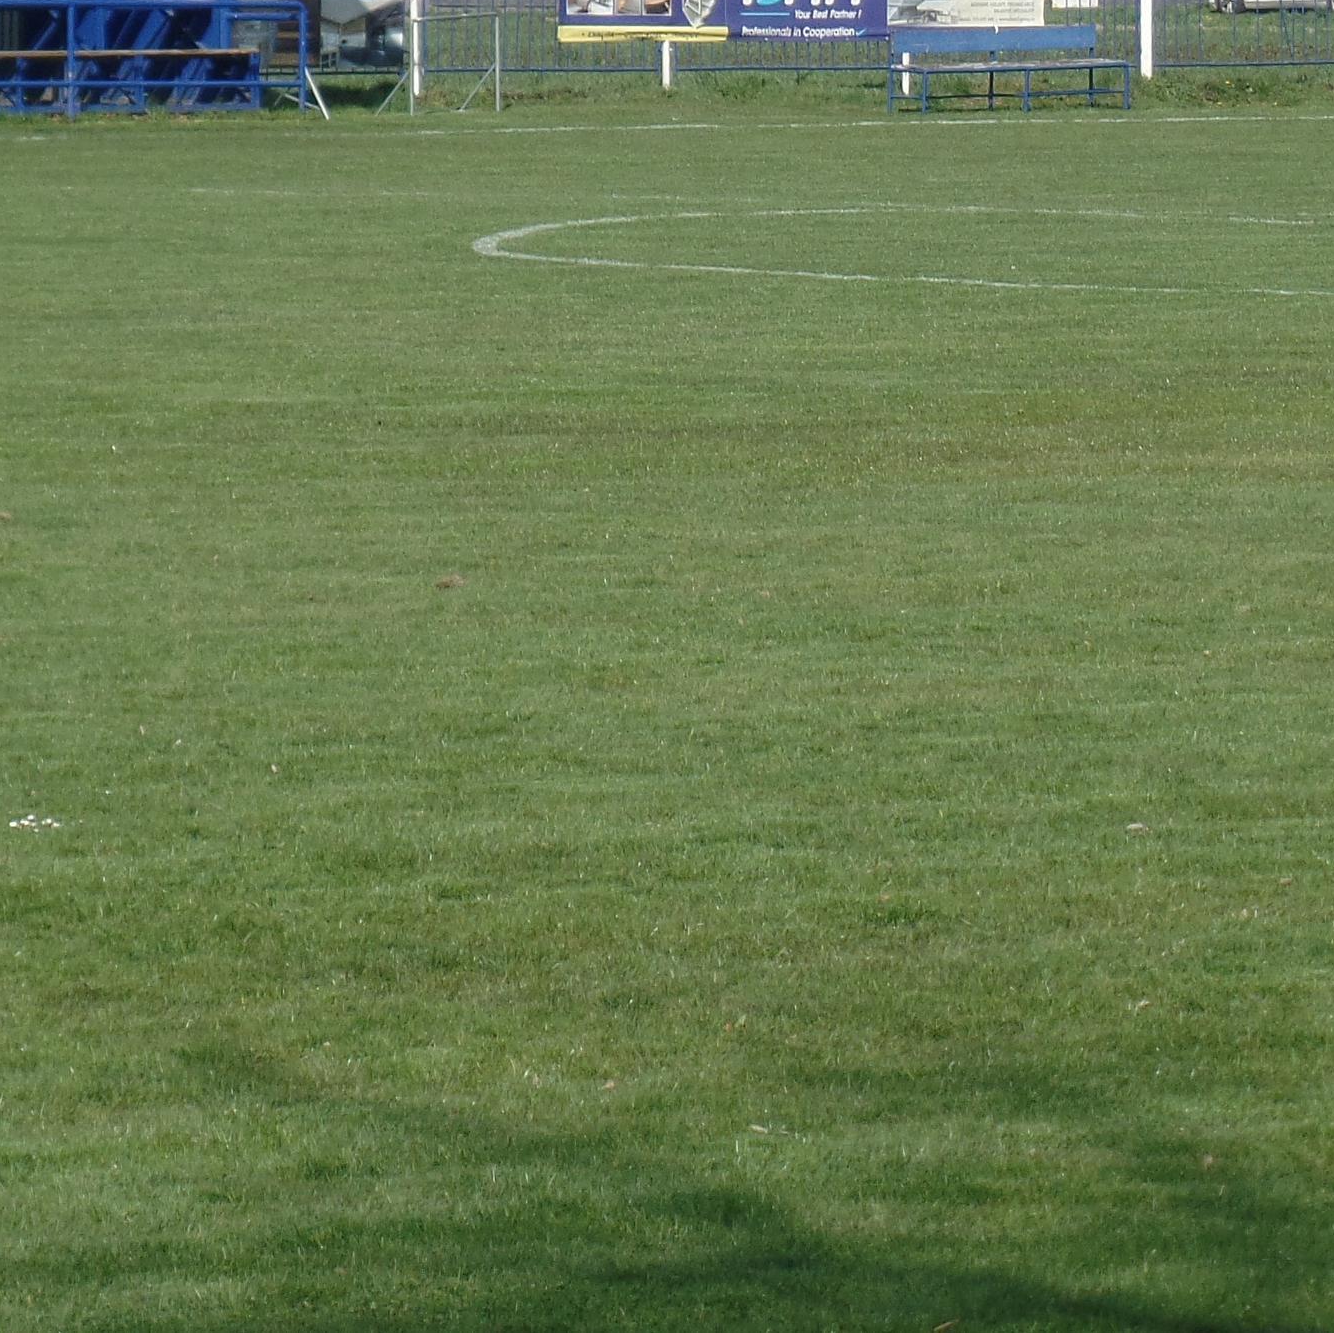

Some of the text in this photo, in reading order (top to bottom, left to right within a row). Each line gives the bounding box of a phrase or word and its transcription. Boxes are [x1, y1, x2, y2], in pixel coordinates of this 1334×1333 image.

[794, 9, 811, 19] Your
[813, 9, 828, 18] Best
[830, 9, 857, 19] Partner
[742, 26, 855, 39] Professionals in Cooperation
